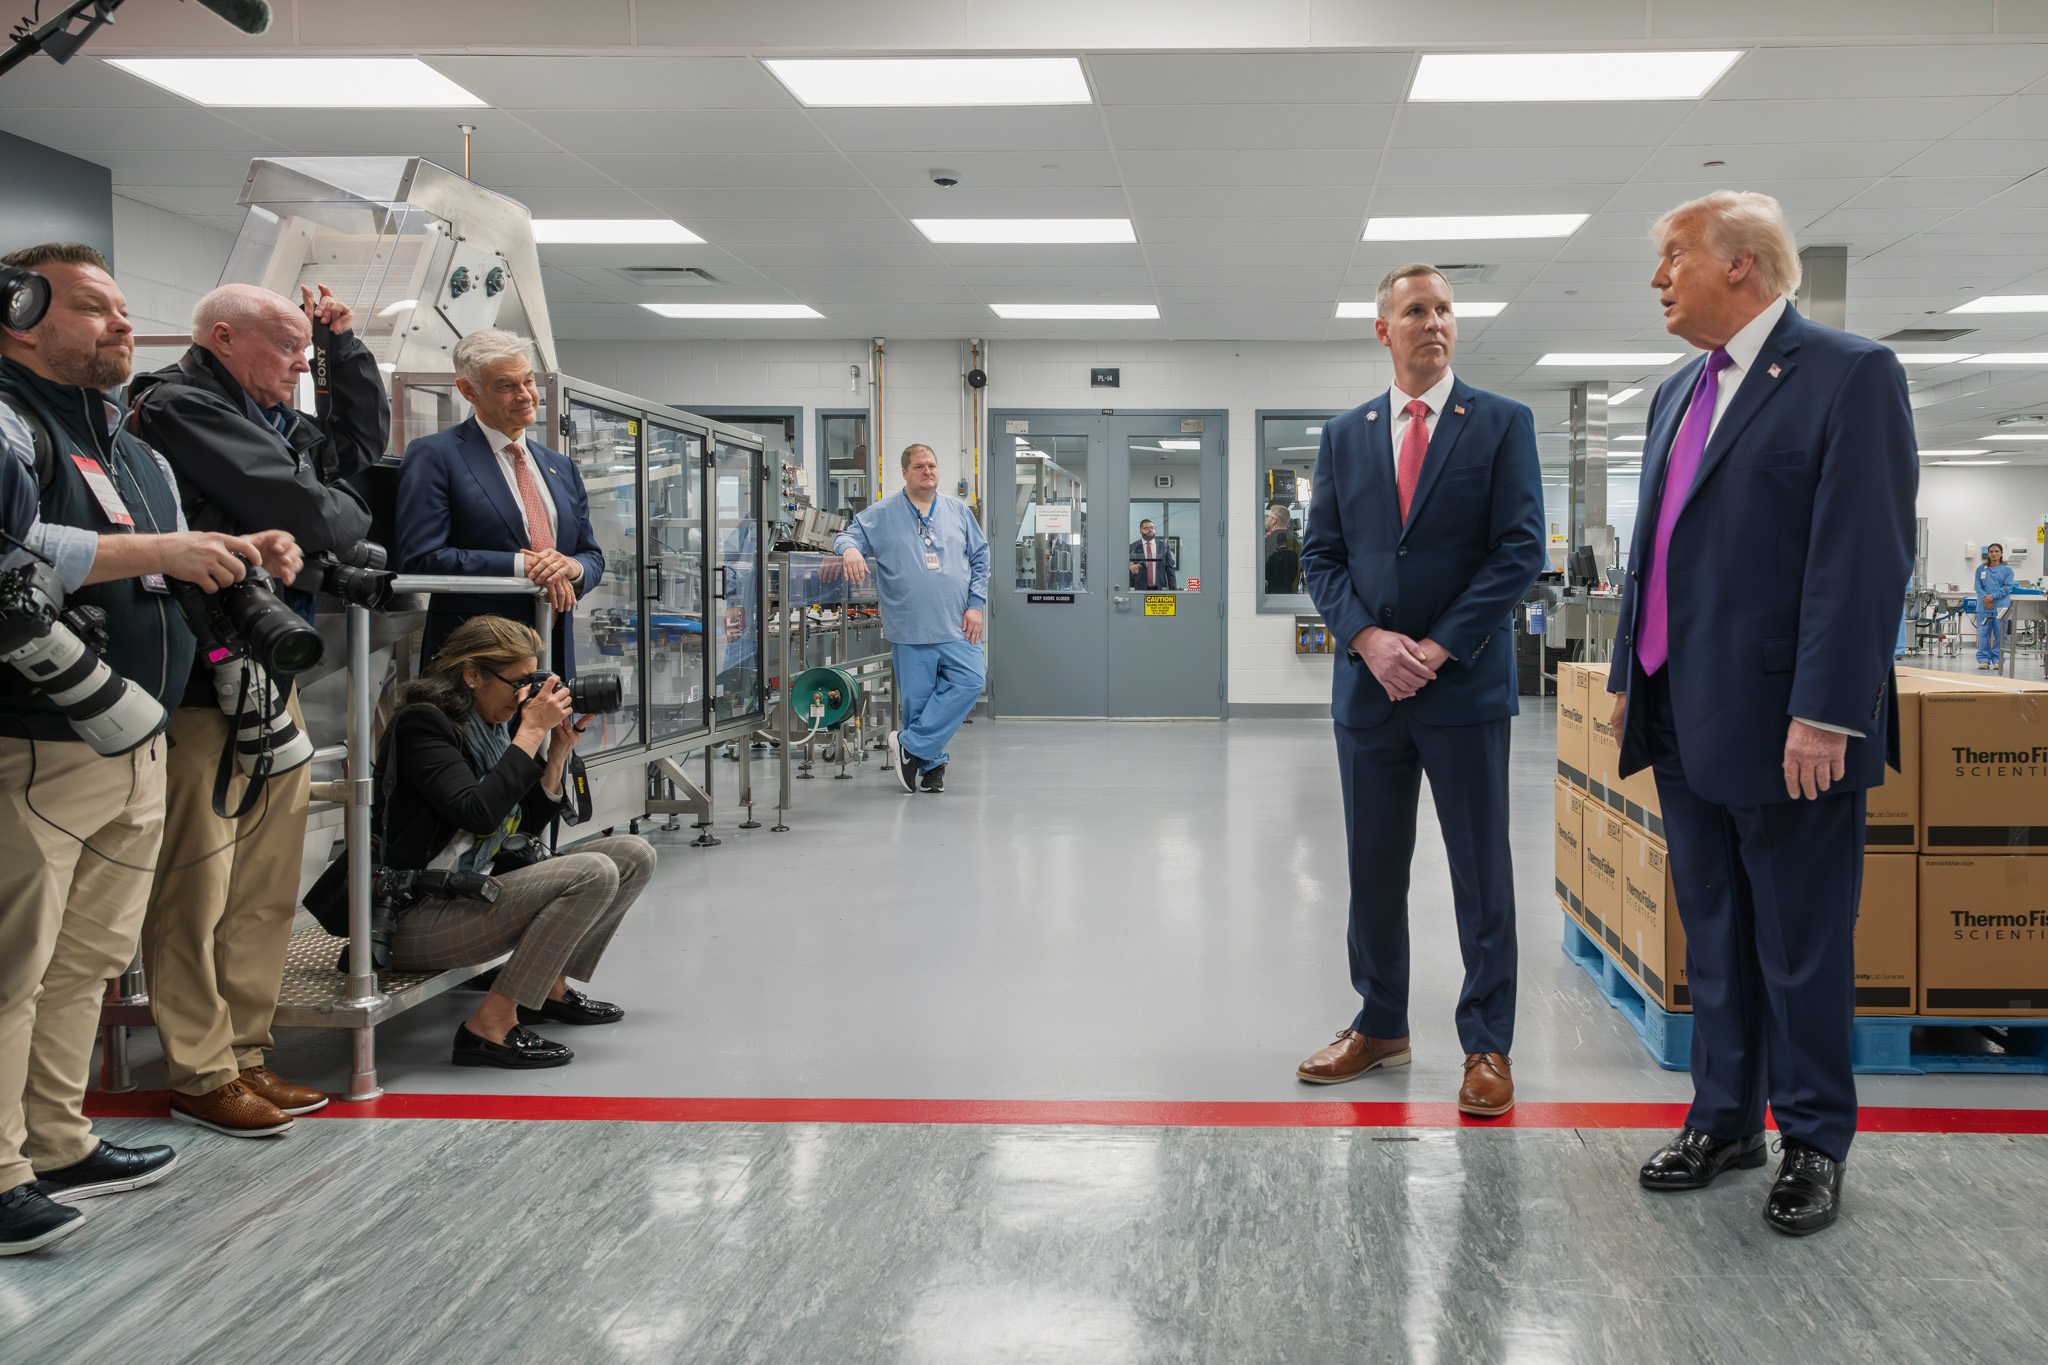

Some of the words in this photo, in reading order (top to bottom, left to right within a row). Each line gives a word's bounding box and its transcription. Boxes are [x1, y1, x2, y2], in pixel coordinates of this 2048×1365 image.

[317, 346, 327, 386] SONY
[1097, 374, 1113, 382] PL-14
[68, 610, 86, 626] Nikon
[1560, 704, 1583, 724] ThermoFisher
[1956, 766, 2047, 777] SCIENTI
[577, 776, 585, 794] Nikon
[1587, 847, 1616, 879] ThermoFisher
[1587, 862, 1615, 890] SCIENTIFIC
[1626, 876, 1657, 914] ThermoFisher
[1626, 894, 1657, 928] SCIENTIFIC
[1954, 929, 2044, 940] SCIENTI
